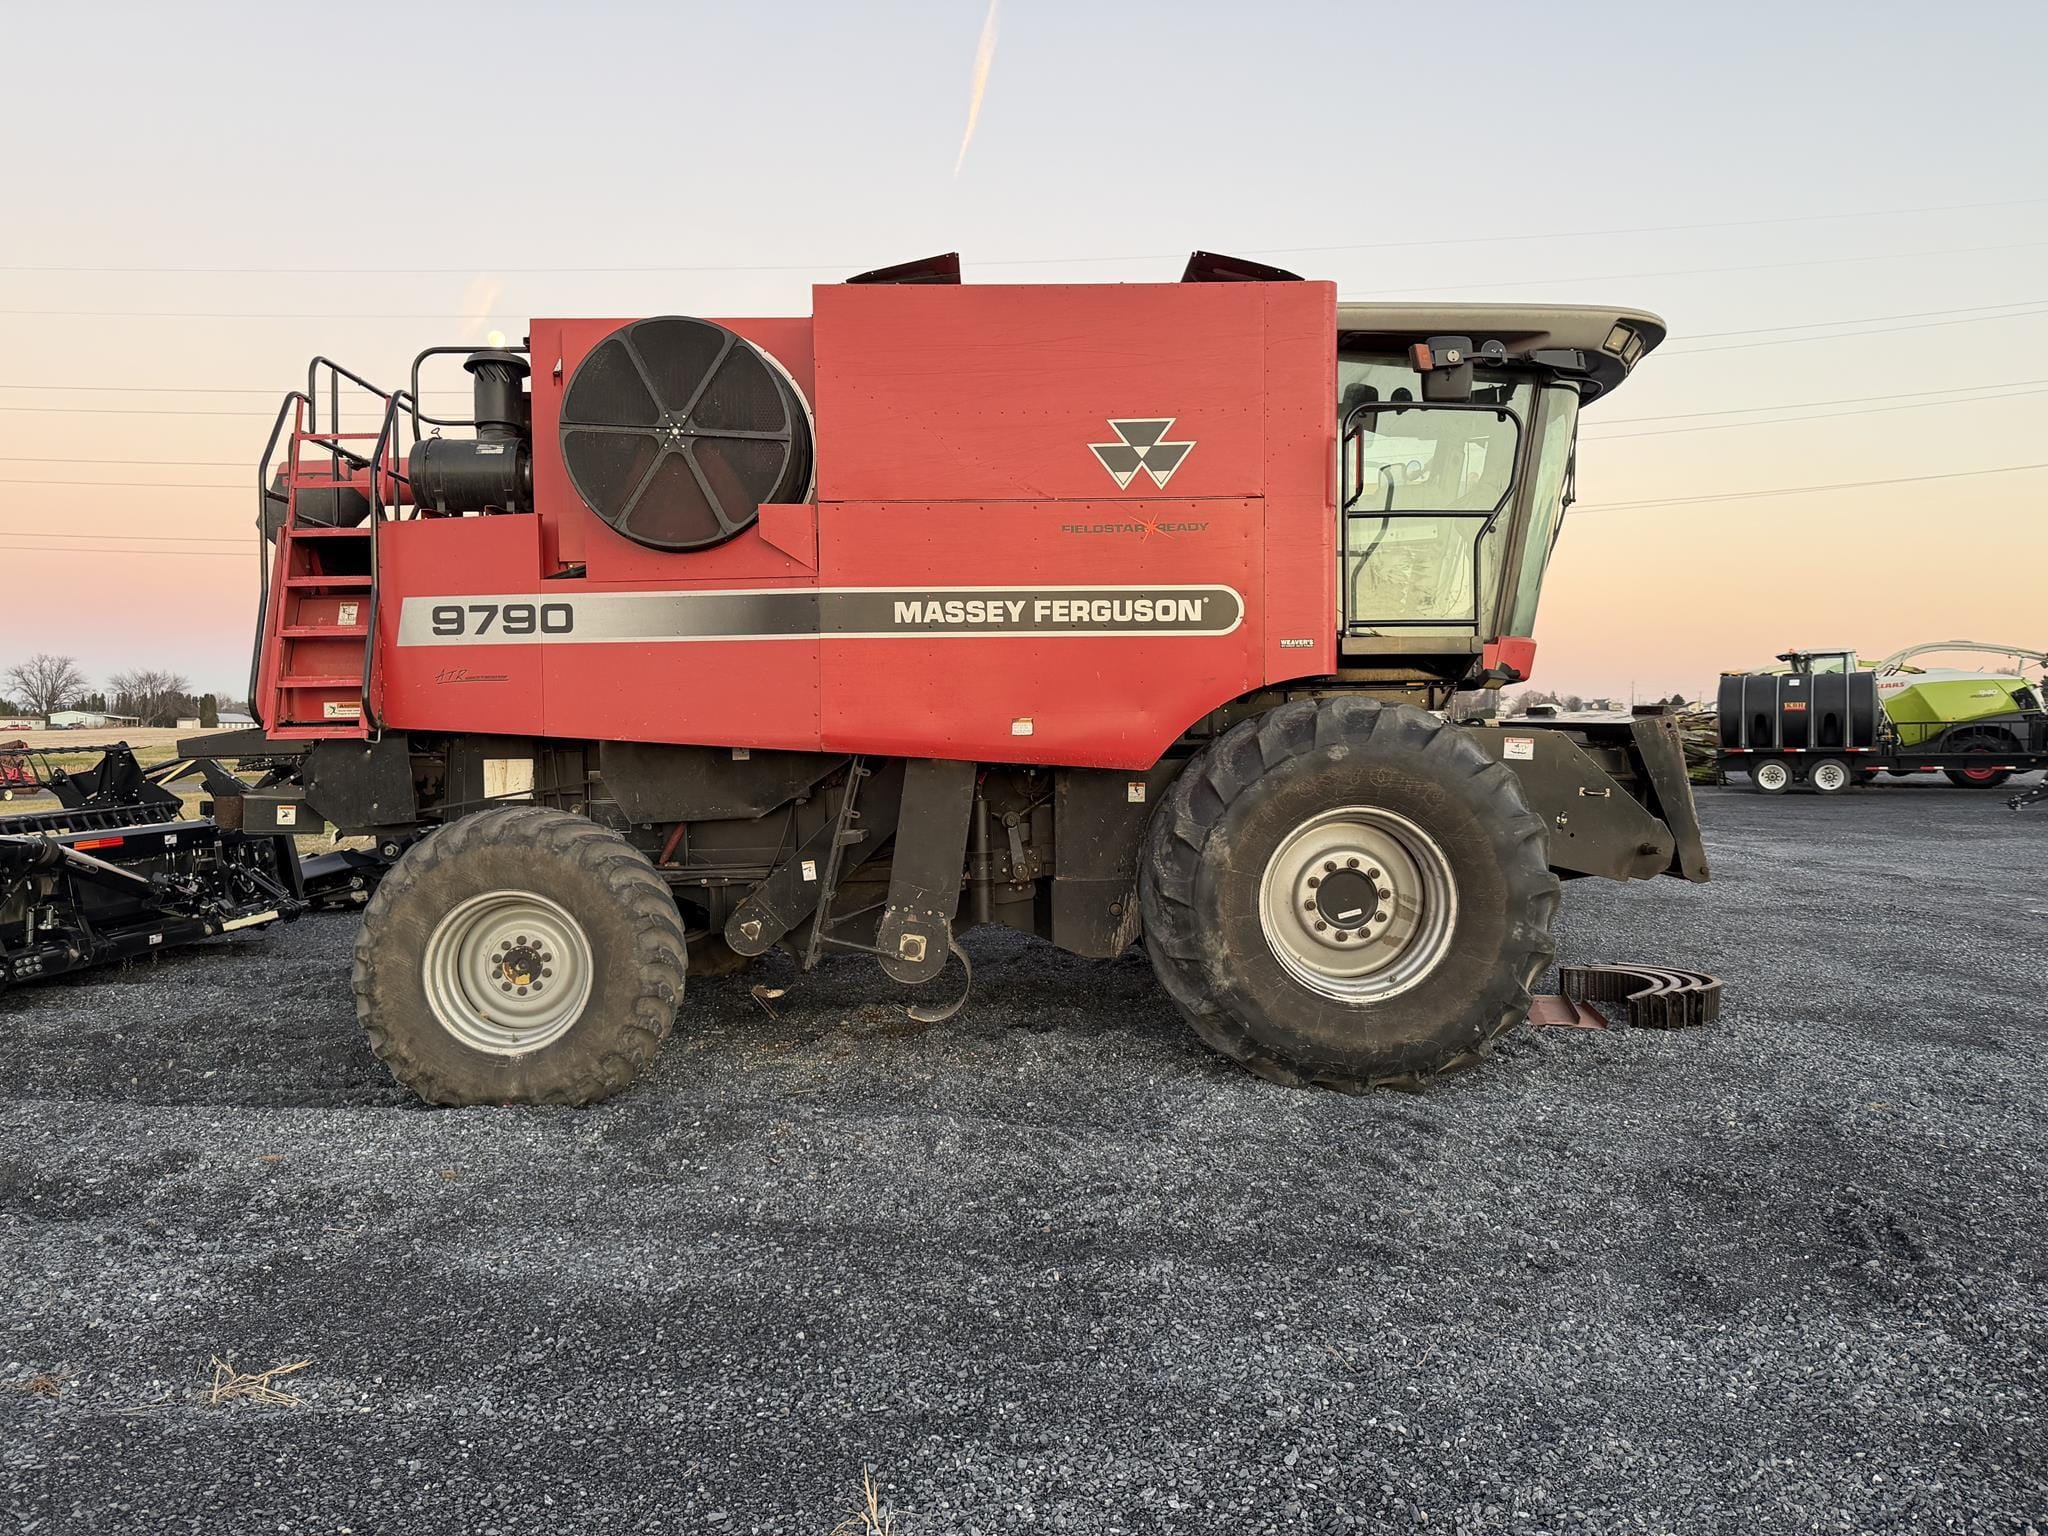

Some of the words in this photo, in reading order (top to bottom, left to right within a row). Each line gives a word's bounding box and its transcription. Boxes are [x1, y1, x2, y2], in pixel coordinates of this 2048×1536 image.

[1061, 524, 1145, 534] FIELDSTAR
[432, 603, 574, 636] 9790
[894, 600, 1026, 624] MASSEY
[1034, 599, 1203, 623] FERGUSON
